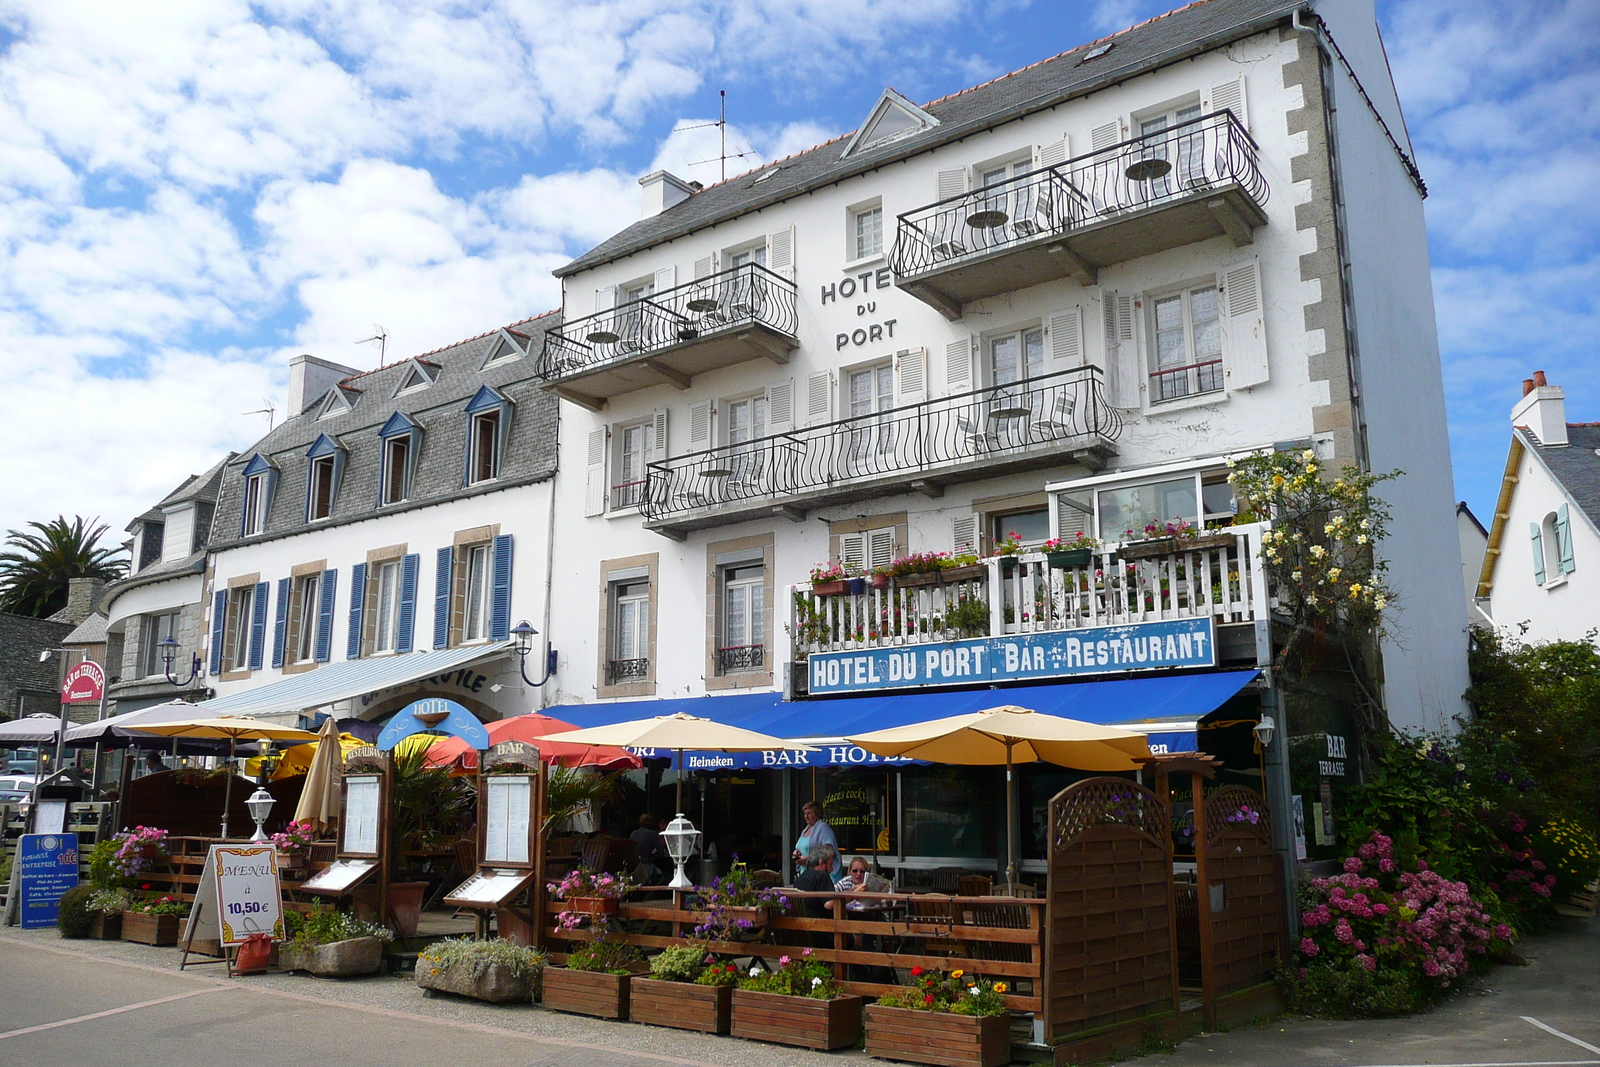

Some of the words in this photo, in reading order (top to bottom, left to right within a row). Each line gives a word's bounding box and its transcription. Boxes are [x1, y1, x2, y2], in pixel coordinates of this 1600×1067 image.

[821, 266, 891, 305] HOTE
[856, 301, 876, 316] DU
[835, 318, 897, 351] PORT
[813, 655, 880, 687] HOTEL
[889, 652, 917, 682] DU
[925, 645, 985, 679] PORT
[1065, 631, 1206, 668] RESTAURANT
[63, 672, 75, 694] BAR
[80, 664, 103, 690] TERRASSE
[413, 699, 451, 715] HOTEL
[347, 746, 385, 761] RESTAURANT
[496, 741, 525, 756] BAR
[1326, 734, 1347, 759] BAR
[688, 755, 734, 768] Heineken
[761, 748, 810, 766] BAR
[1318, 760, 1345, 776] TERRASSE
[57, 852, 77, 865] 10€
[224, 864, 270, 877] MENU
[244, 884, 251, 895] à
